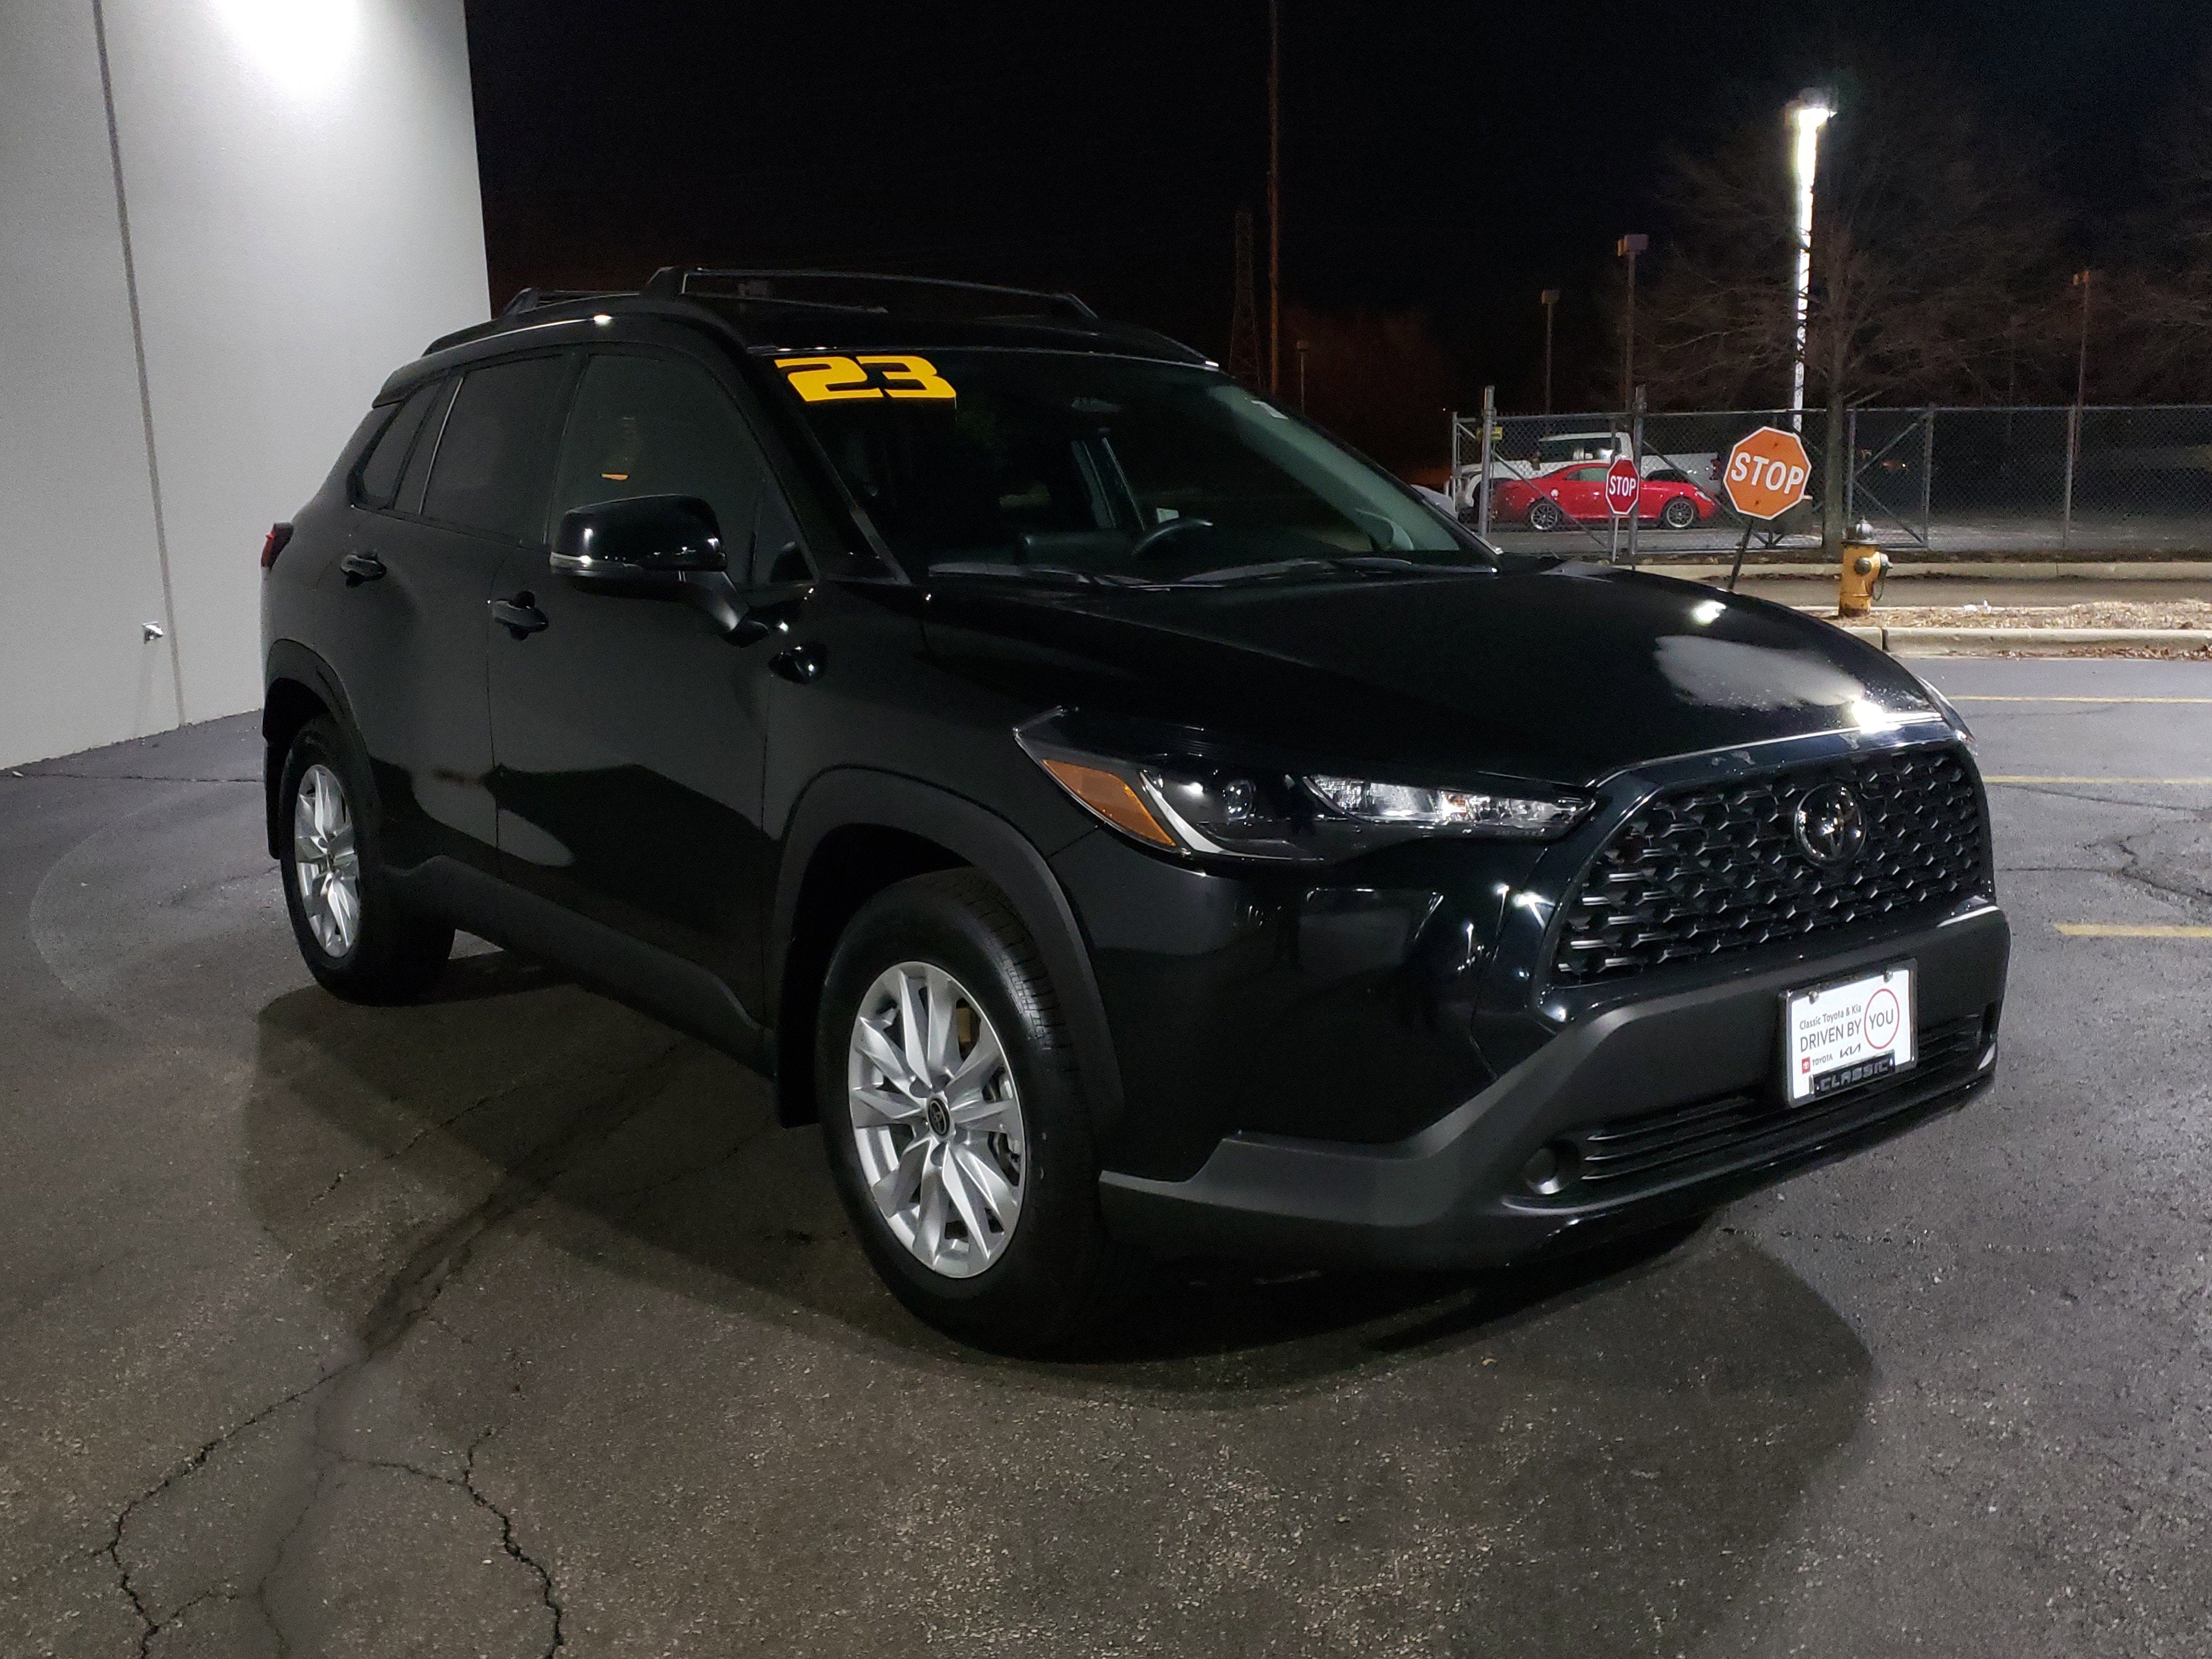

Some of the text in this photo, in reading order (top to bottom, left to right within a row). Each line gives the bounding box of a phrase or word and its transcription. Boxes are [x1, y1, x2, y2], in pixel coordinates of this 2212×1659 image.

[774, 356, 956, 402] 23
[1609, 475, 1637, 497] STOP
[1731, 452, 1804, 494] STOP
[1799, 1004, 1861, 1030] Classic Toyota & Kia
[1801, 1008, 1893, 1052] DRIVEN BY YOU
[1812, 1053, 1833, 1066] TOYOTA
[1820, 1060, 1889, 1091] CLASSIC
